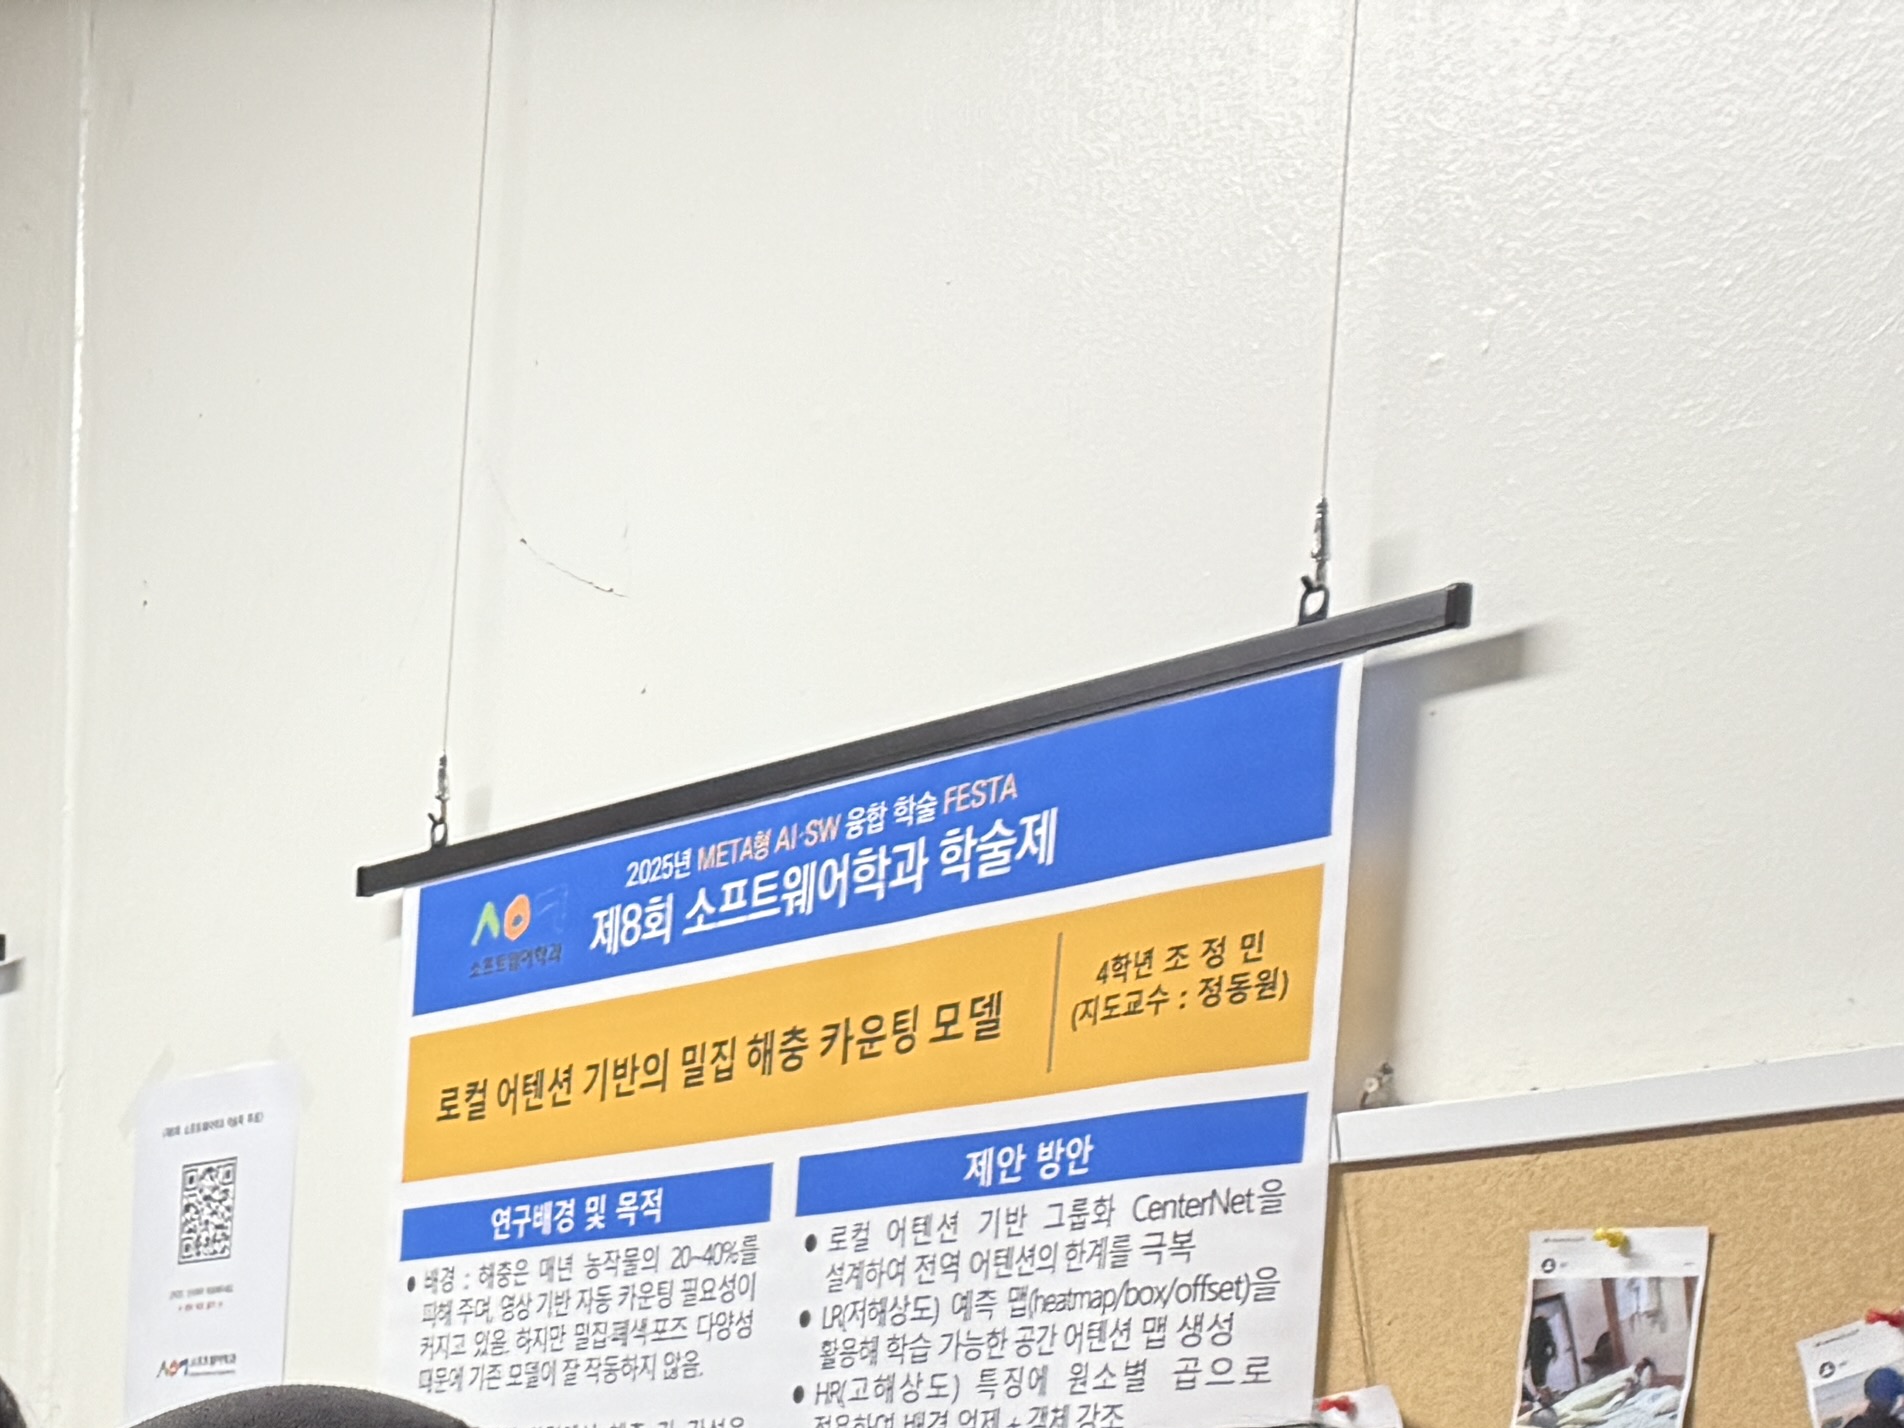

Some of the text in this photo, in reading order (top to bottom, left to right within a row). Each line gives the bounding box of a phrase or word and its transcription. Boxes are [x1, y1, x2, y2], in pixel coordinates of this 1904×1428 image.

[625, 848, 691, 888] 2025년
[697, 828, 772, 871] META형
[845, 801, 888, 840] 융합
[893, 790, 937, 827] 학술
[943, 773, 1018, 815] FESTA
[590, 807, 1058, 955] 제8회 소프트웨어학과 학술제
[1096, 929, 1264, 985] 4학년 조 정 민
[1071, 983, 1170, 1032] (지도교수
[1198, 966, 1289, 1009] 정동원)
[436, 990, 1003, 1121] 로컬 어텐션 기반의 밀집 해충 카운팅 모델
[963, 1134, 1094, 1189] 제안 방안
[491, 1187, 664, 1241] 연구배경 및 목적
[827, 1179, 1286, 1253] 로컬 어텐션 기반 그룹화 CenterNet을
[478, 1258, 529, 1289] 해충은
[539, 1253, 573, 1283] 매년
[584, 1245, 660, 1280] 농작물의
[826, 1229, 1196, 1294] 설계하여 전역 어텐션의 한계를 극복
[501, 1292, 532, 1322] 영상
[536, 1289, 571, 1318] 기반
[575, 1285, 612, 1315] 자동
[618, 1280, 674, 1311] 카운팅
[680, 1271, 757, 1307] 필요성이
[822, 1295, 940, 1332] LR(저해상도)
[420, 1333, 467, 1360] 커지고
[516, 1324, 566, 1354] 하지만
[697, 1309, 754, 1342] 다양성
[820, 1311, 1234, 1370] 활용해 학습 가능한 공간 어텐션 맵 생성
[418, 1365, 463, 1394] 때문에
[469, 1363, 502, 1391] 기존
[505, 1360, 556, 1389] 모델이
[563, 1358, 580, 1386] 잘
[585, 1353, 657, 1384] 작동하지
[815, 1355, 1272, 1408] HR(고해상도) 특징에 원소별 곱으로
